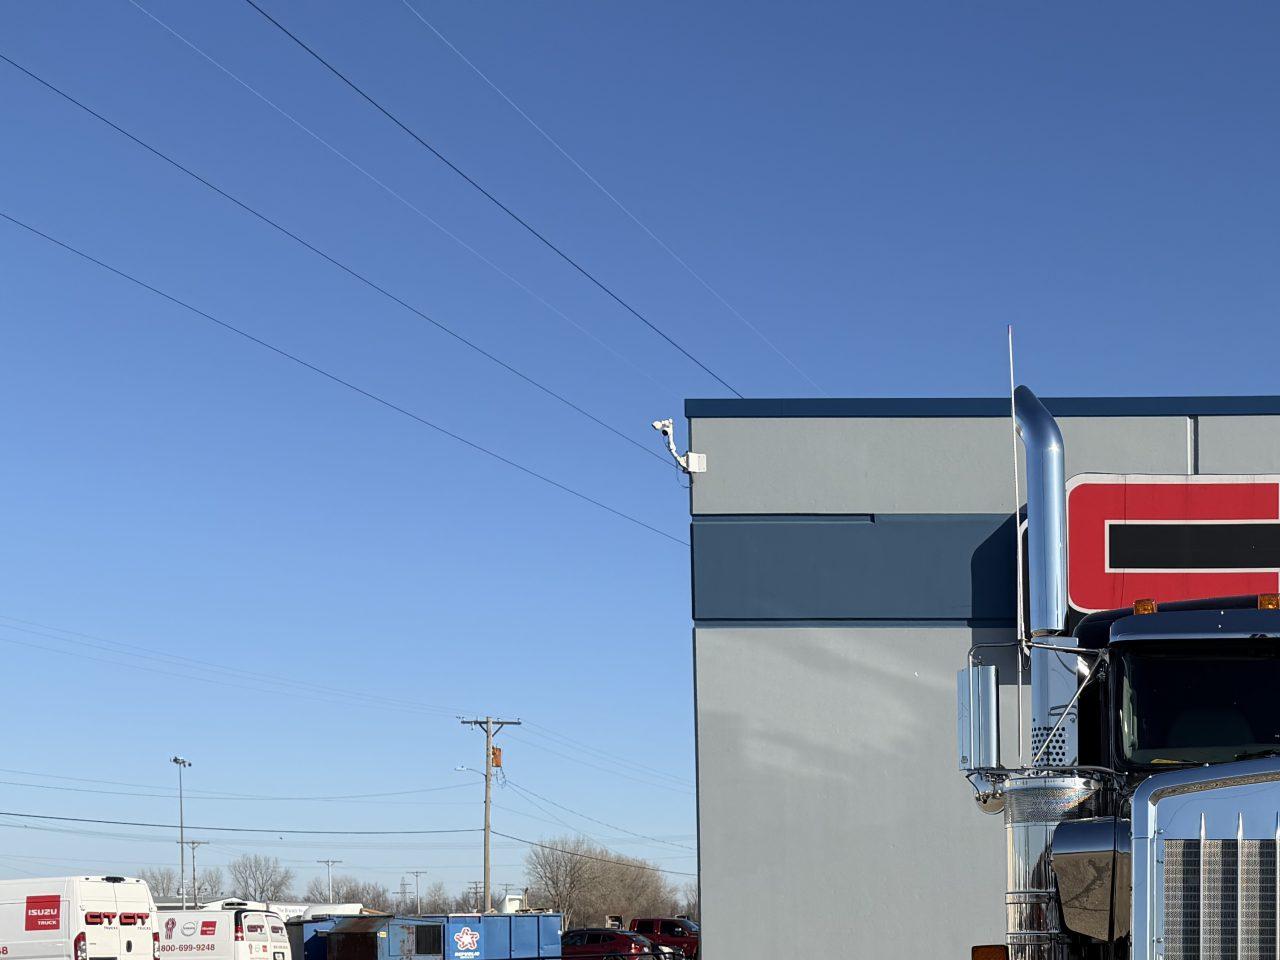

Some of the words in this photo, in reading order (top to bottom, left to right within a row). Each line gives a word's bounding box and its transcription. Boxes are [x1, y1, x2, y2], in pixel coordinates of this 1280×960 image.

[85, 911, 117, 925] CIT
[119, 912, 149, 925] CIT
[161, 944, 215, 952] 800-699-9248
